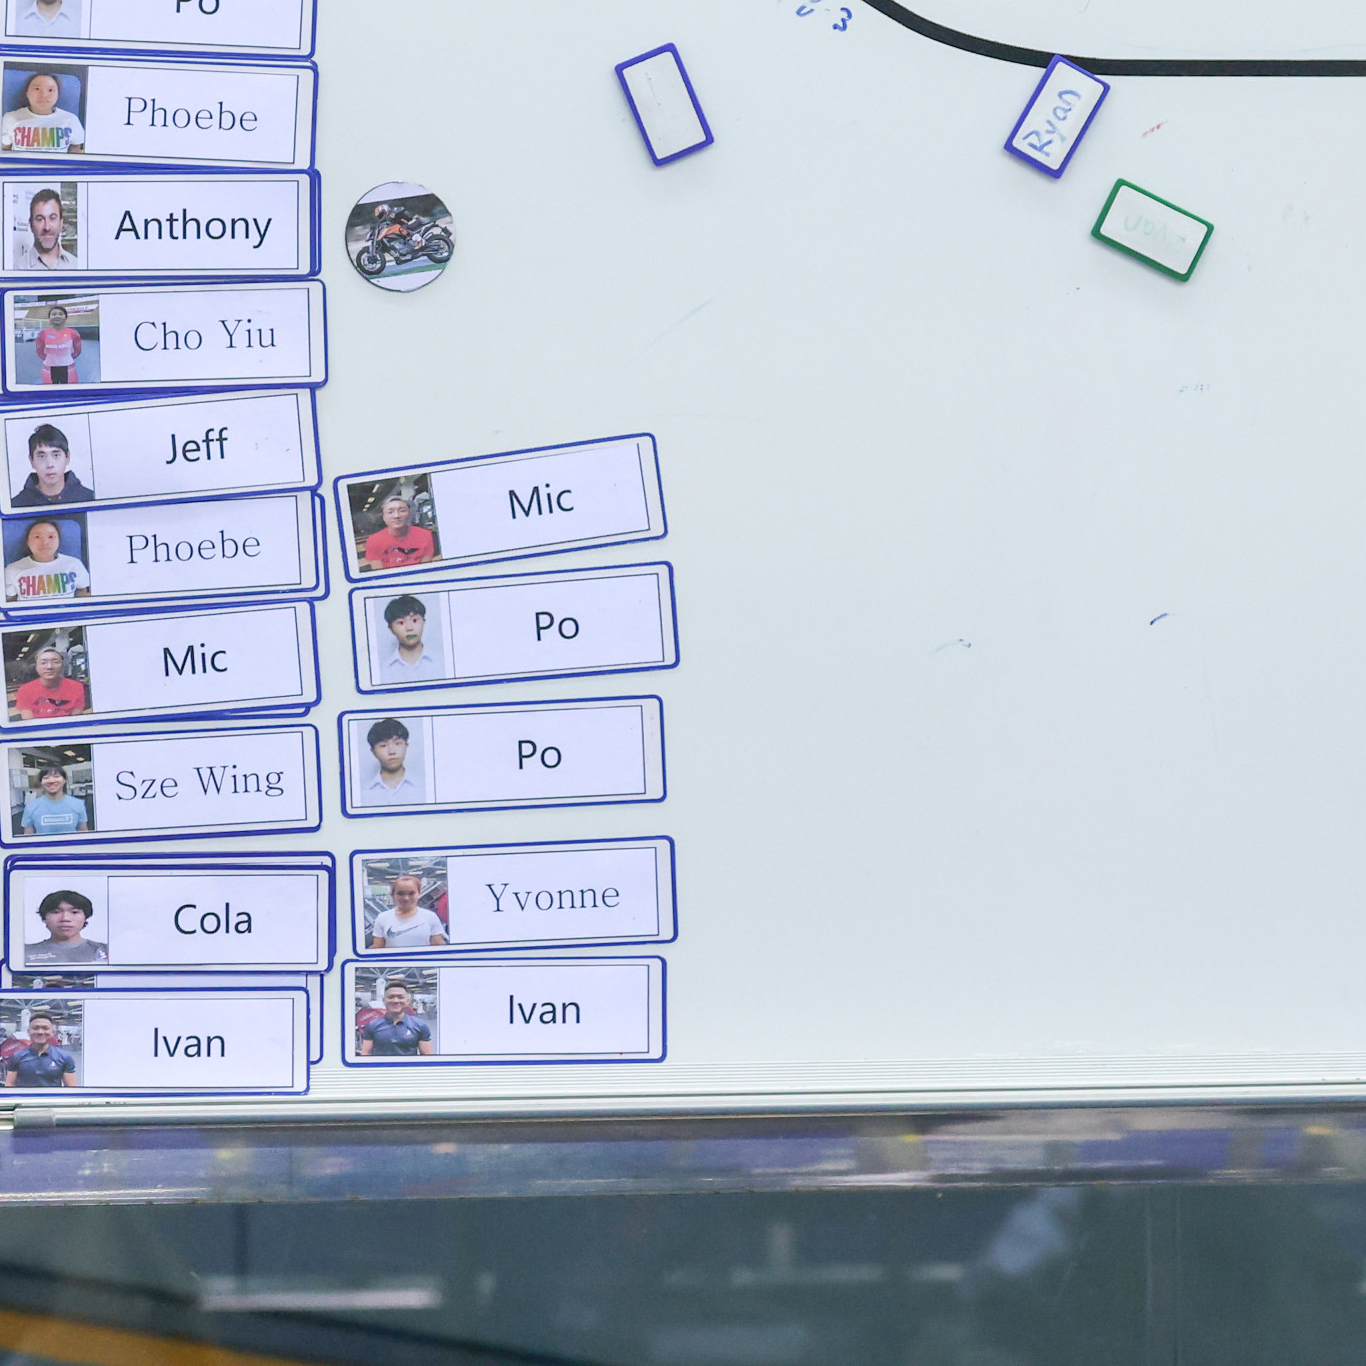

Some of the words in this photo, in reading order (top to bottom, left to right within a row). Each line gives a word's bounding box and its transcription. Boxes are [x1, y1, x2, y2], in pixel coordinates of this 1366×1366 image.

[124, 96, 258, 132] Phoebe
[1022, 89, 1082, 158] Ryan
[14, 127, 72, 147] CHAMPS
[115, 208, 273, 249] Anthony
[134, 321, 203, 352] Cho
[219, 318, 277, 349] Yiu
[165, 427, 229, 465] Jeff
[509, 482, 574, 520] Mic
[126, 529, 261, 565] Phoebe
[18, 572, 76, 596] CHAMPS
[535, 611, 580, 642] Po
[162, 643, 228, 677] Mic
[517, 739, 562, 770] Po
[116, 770, 178, 801] Sze
[194, 765, 284, 798] Wing
[486, 882, 620, 913] Yvonne
[173, 901, 253, 935] Cola
[509, 994, 581, 1025] Ivan
[153, 1027, 225, 1058] Ivan
